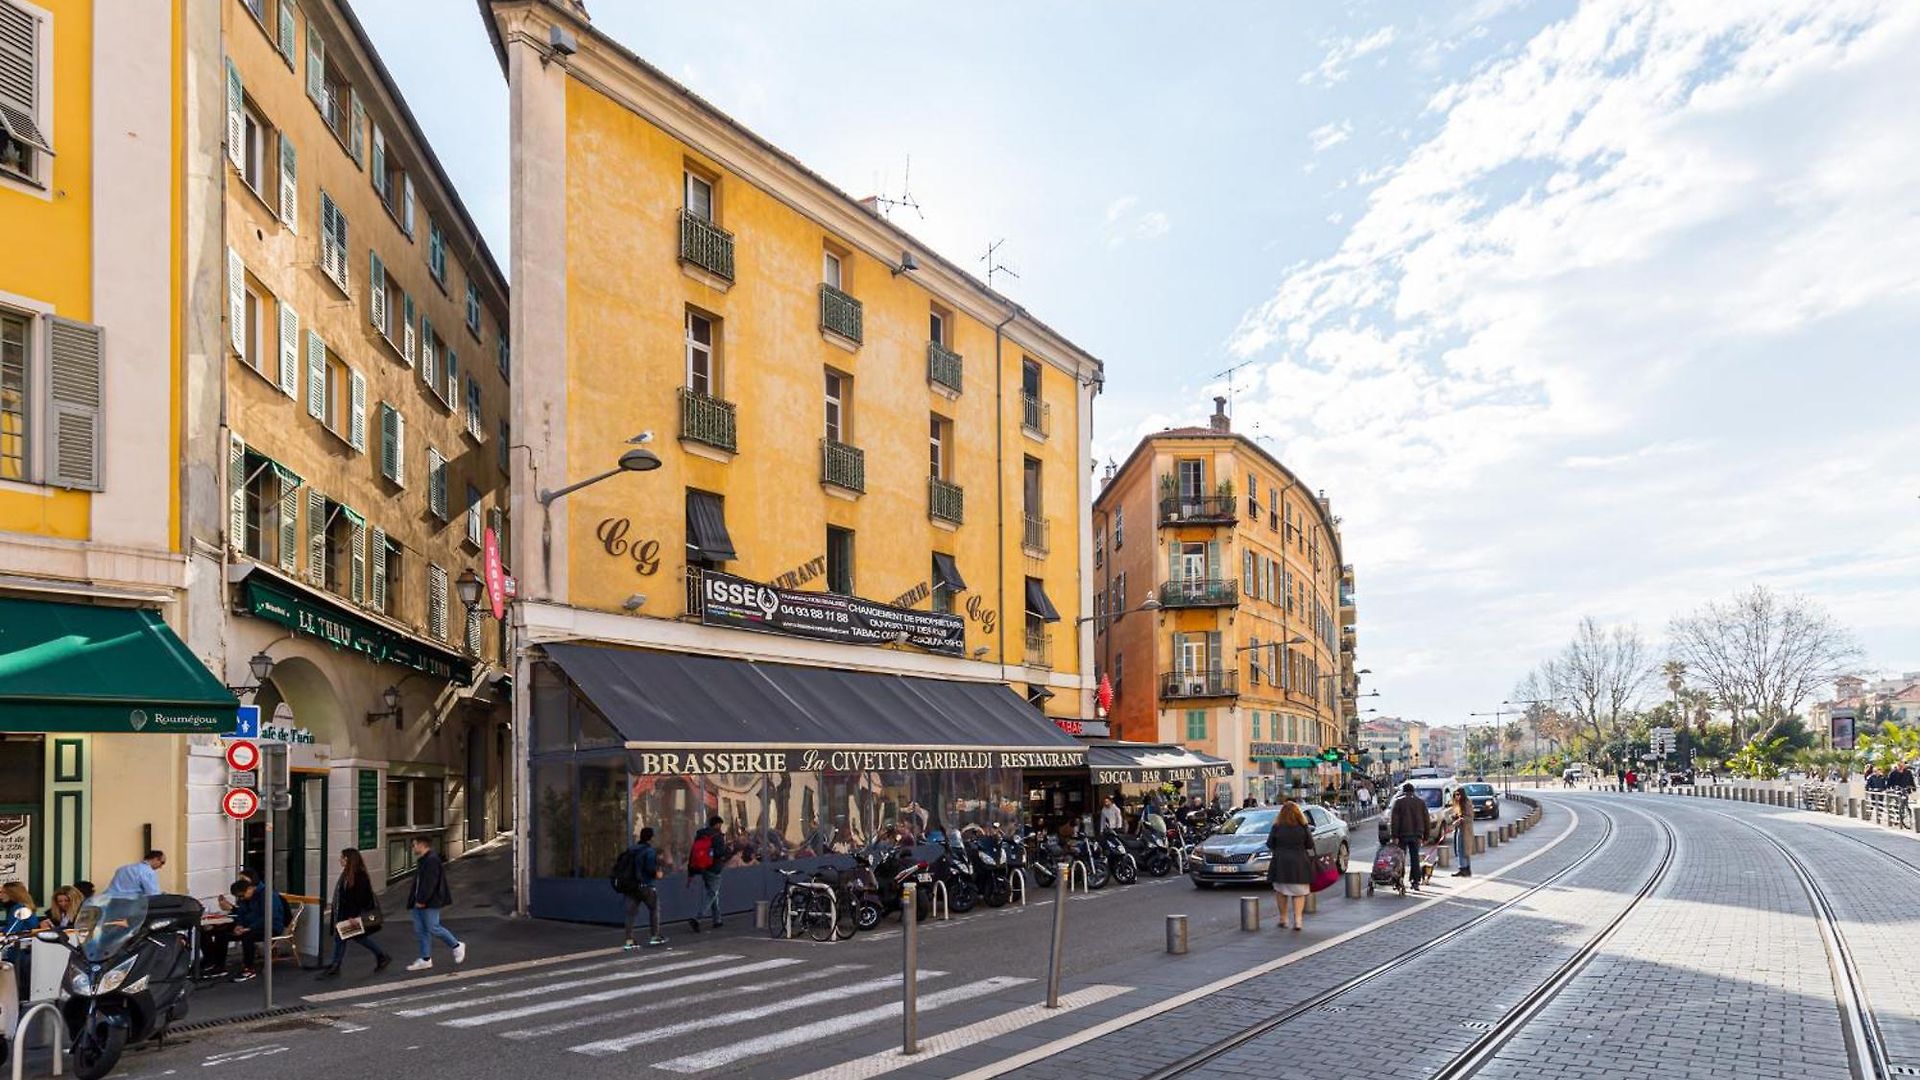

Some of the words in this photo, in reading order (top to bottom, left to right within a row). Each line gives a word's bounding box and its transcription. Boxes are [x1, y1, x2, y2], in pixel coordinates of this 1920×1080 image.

[489, 547, 500, 601] TABAC
[781, 605, 795, 615] 04
[796, 608, 810, 617] 93
[811, 609, 824, 619] 88
[826, 611, 835, 621] 11
[836, 613, 848, 623] 88
[851, 627, 880, 639] TABAC
[155, 713, 217, 726] Roumégous
[261, 726, 277, 740] afé
[278, 727, 288, 741] de
[290, 728, 316, 744] Turin
[641, 752, 787, 775] BRASSERIE
[800, 749, 828, 771] La
[831, 752, 908, 771] CIVETTE
[912, 752, 993, 770] GARIBALDI
[1000, 753, 1084, 768] RESTAURANT
[1099, 771, 1133, 784] SOCCA
[1142, 771, 1160, 782] BAR
[1169, 768, 1195, 780] TABAC
[1202, 766, 1227, 778] SNACK
